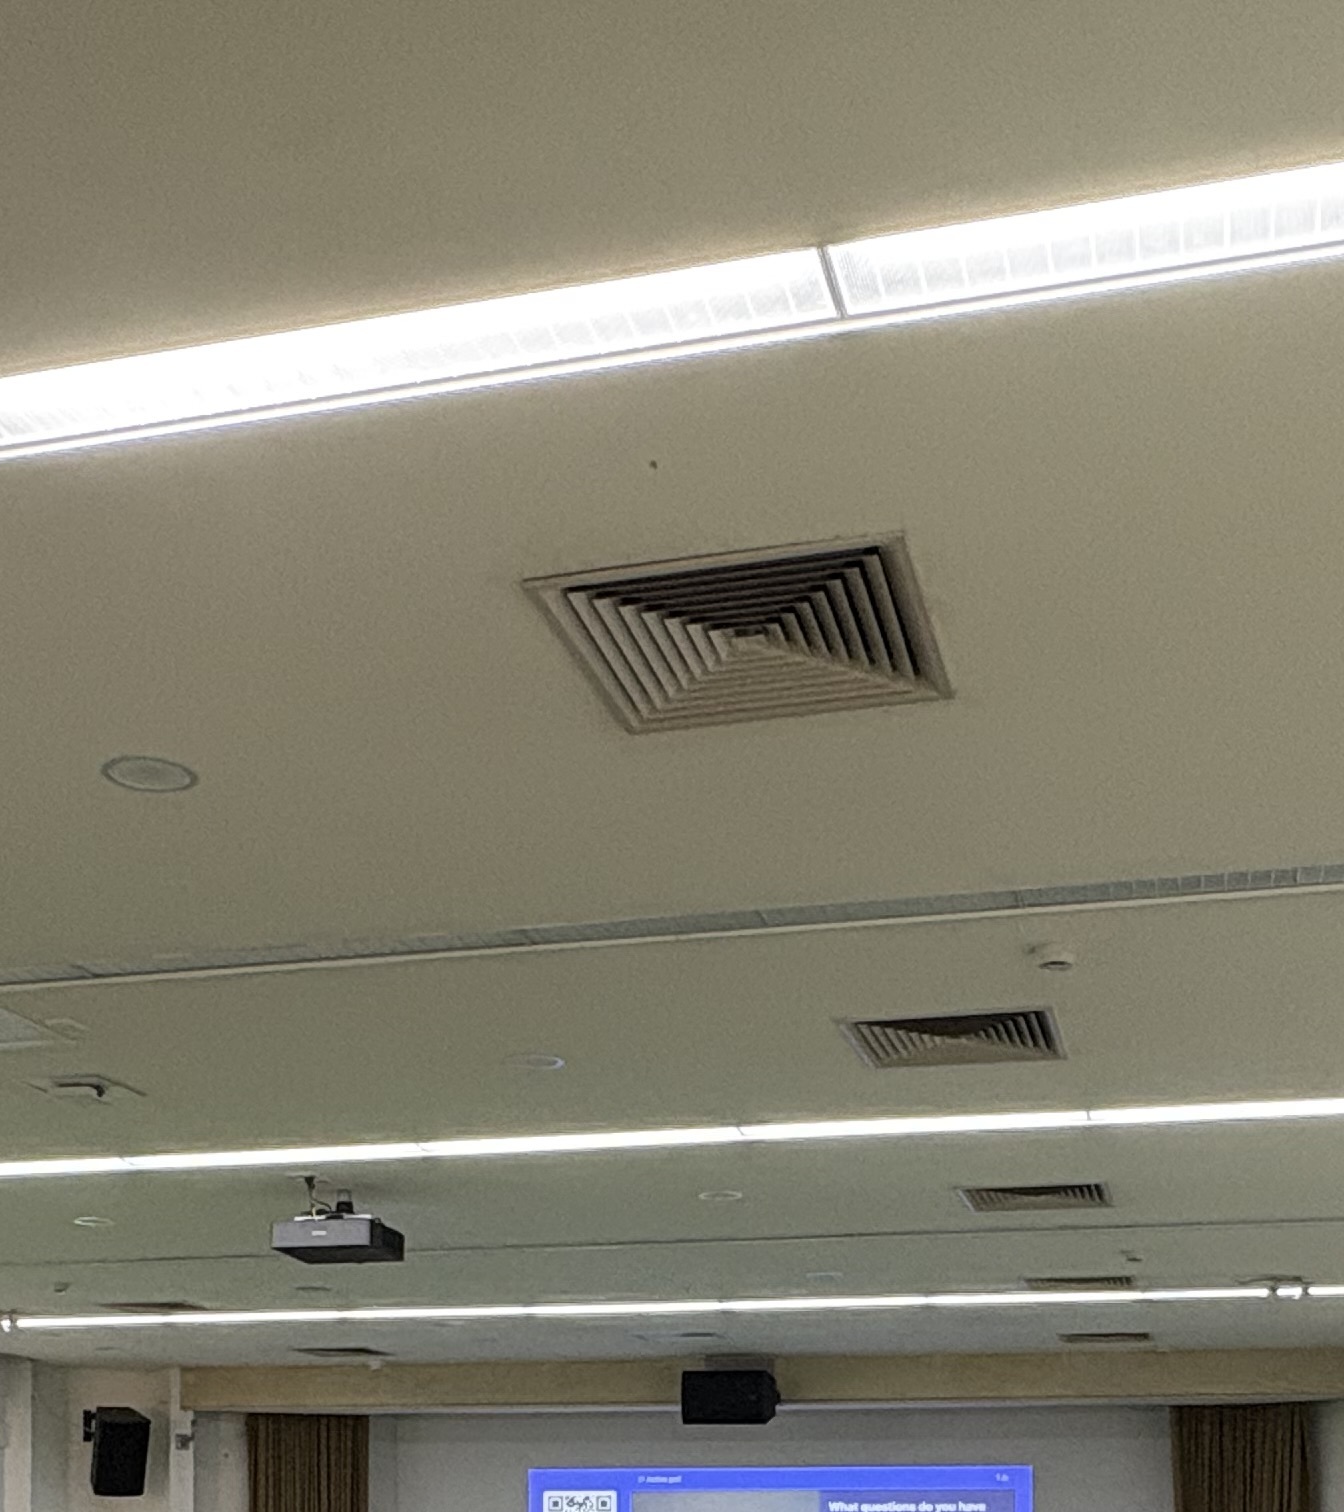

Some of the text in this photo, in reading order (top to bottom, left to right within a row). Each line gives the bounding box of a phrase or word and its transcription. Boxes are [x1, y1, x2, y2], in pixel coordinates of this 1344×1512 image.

[828, 1501, 859, 1512] What
[918, 1501, 934, 1512] do
[958, 1501, 987, 1512] have
